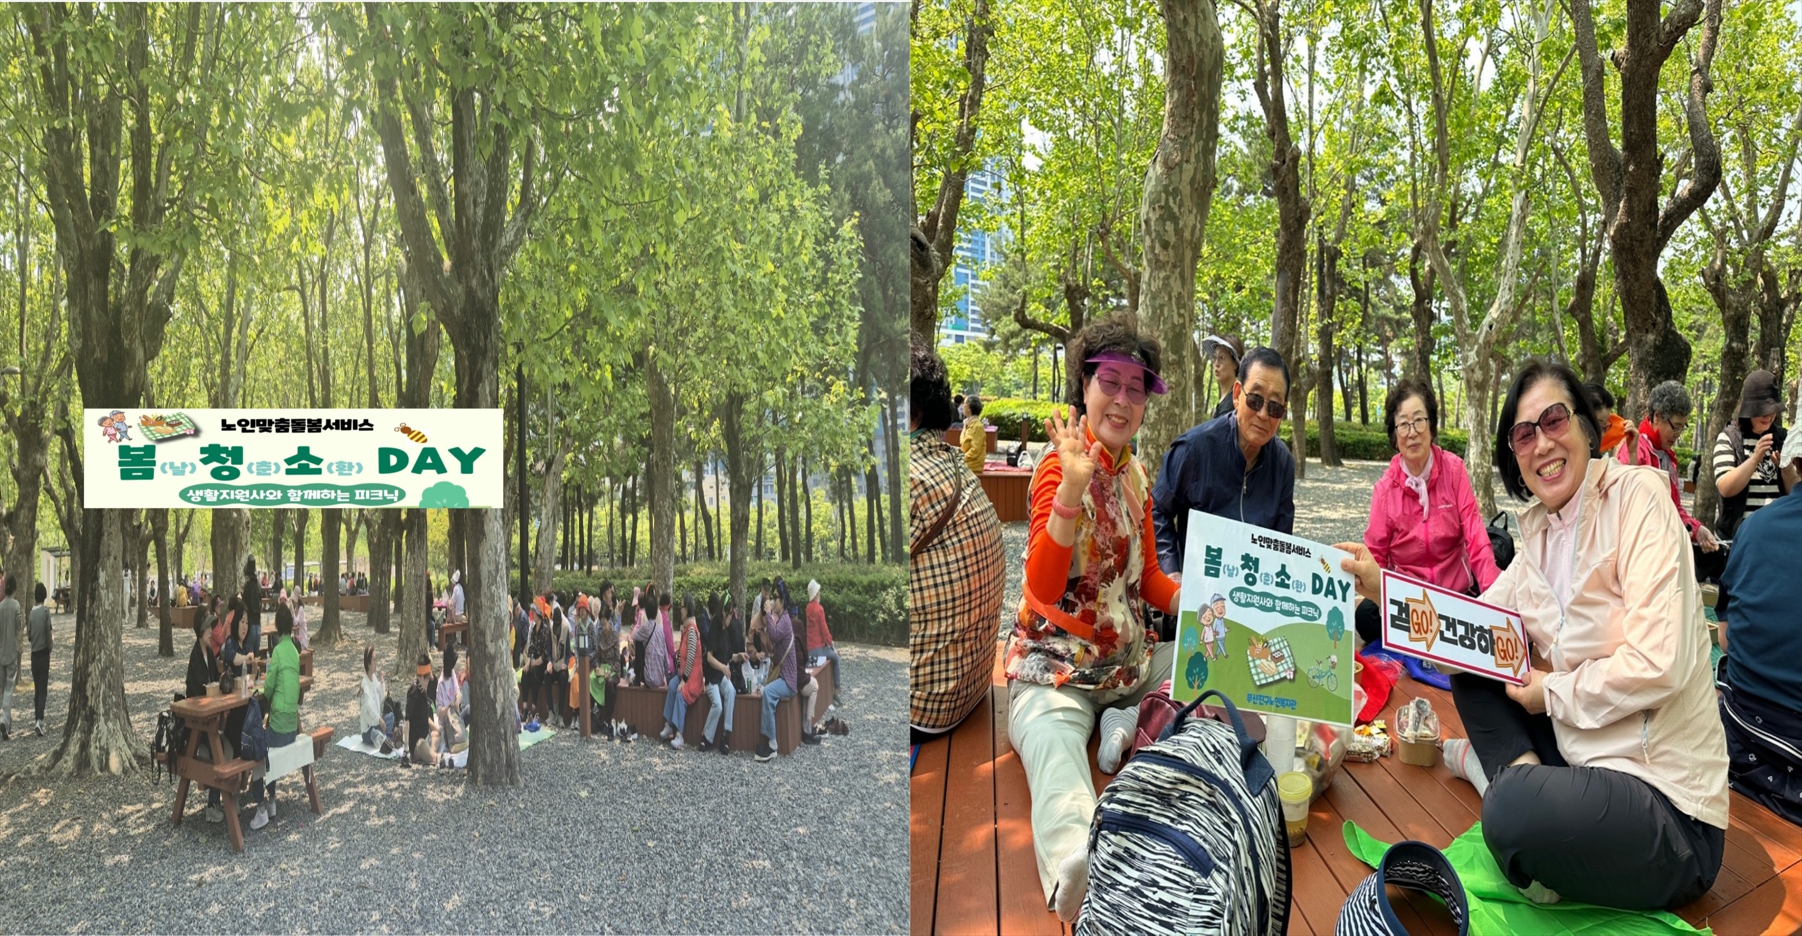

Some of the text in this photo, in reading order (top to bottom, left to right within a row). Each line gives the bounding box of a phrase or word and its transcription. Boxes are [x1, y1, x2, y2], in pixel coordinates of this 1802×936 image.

[1250, 533, 1312, 558] 노인맞춤돌봄서비스
[1311, 572, 1351, 603] DAY
[1232, 590, 1320, 619] 생활지원사와 함께하는 피크닉
